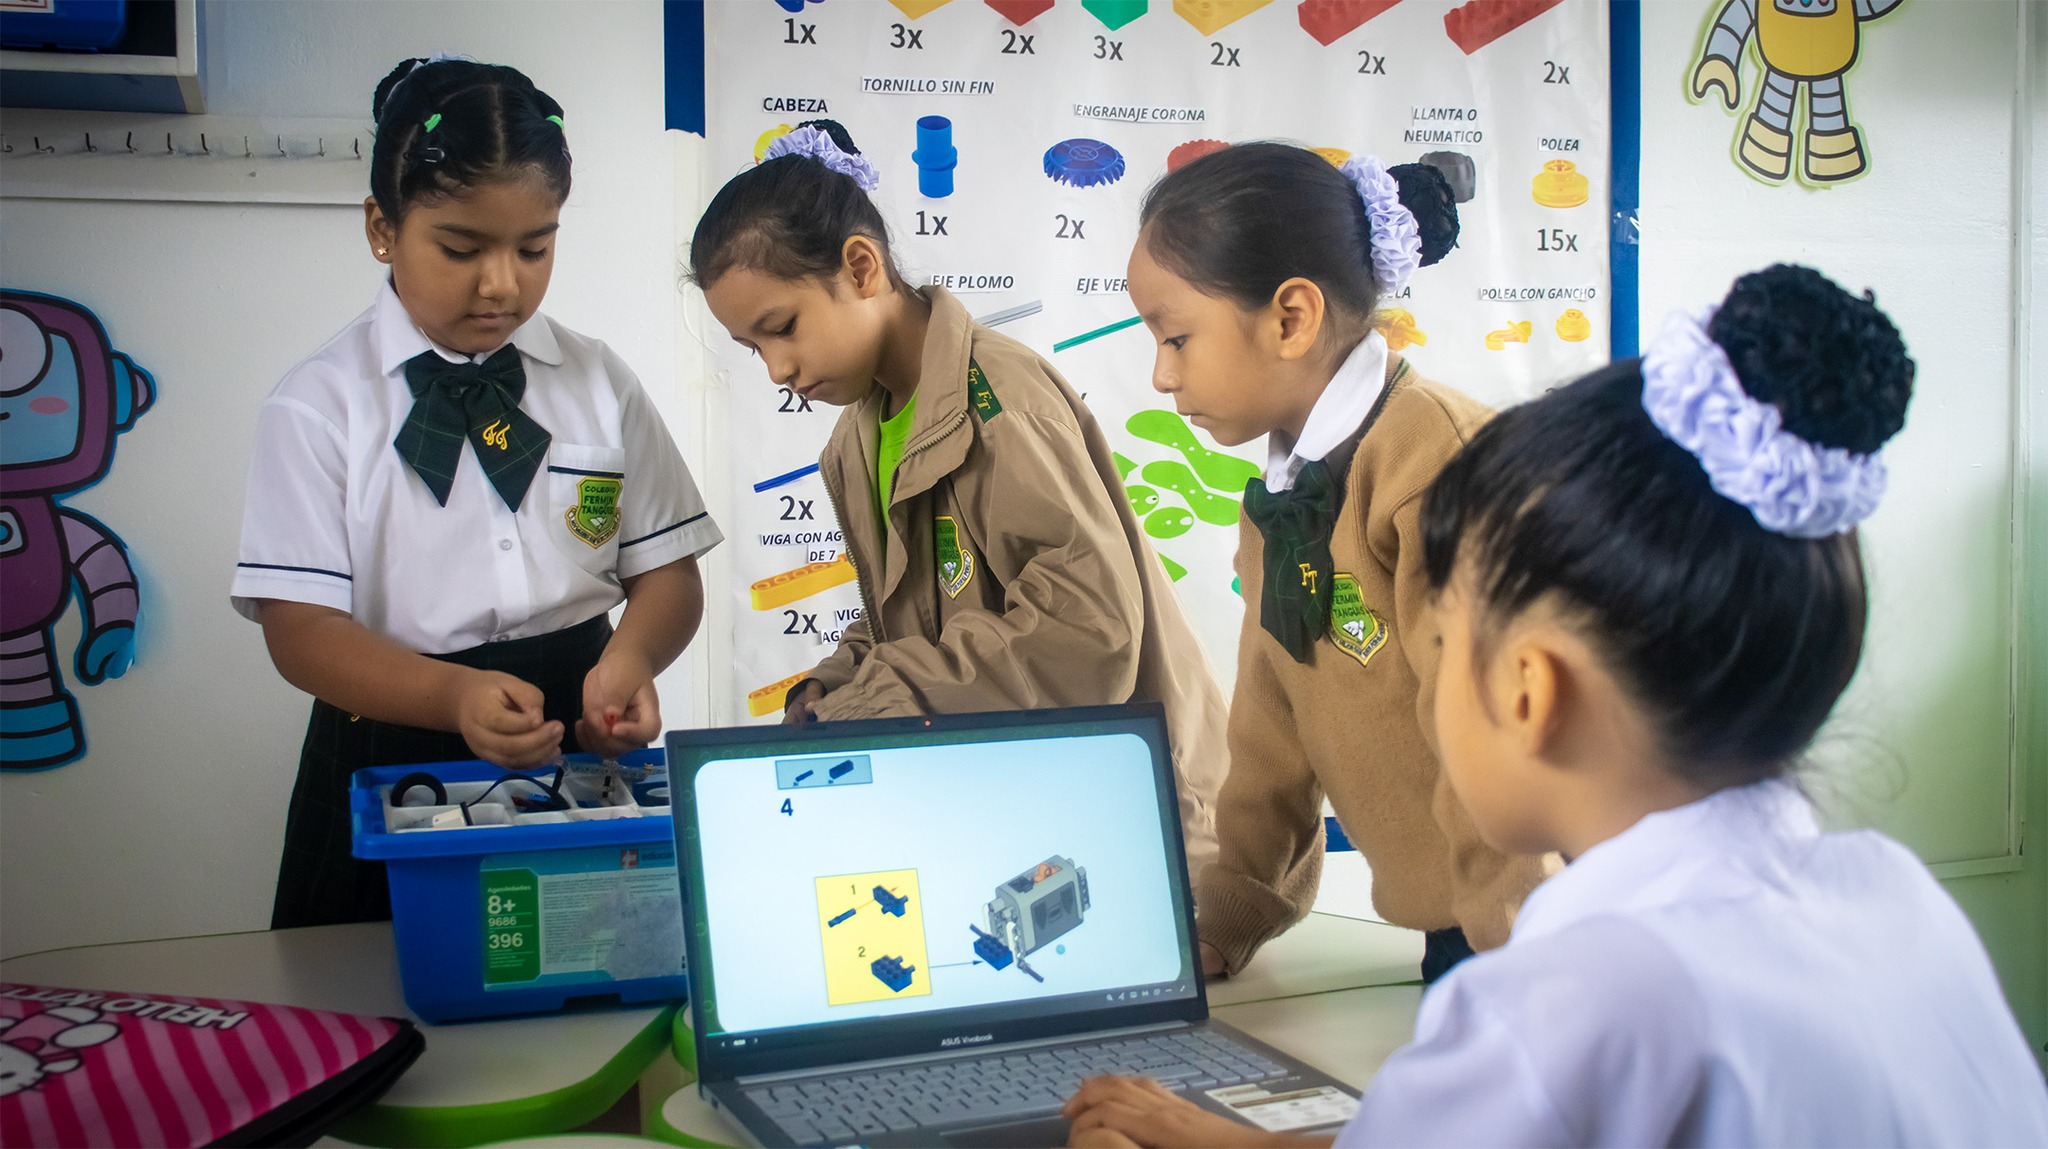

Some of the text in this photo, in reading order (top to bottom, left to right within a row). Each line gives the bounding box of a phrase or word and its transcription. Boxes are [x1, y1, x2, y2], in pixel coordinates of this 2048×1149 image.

[783, 18, 817, 45] 1x
[890, 23, 923, 50] 3x
[1001, 29, 1035, 55] 2x
[1094, 35, 1124, 61] 3x
[1210, 42, 1241, 67] 2x
[1357, 50, 1386, 75] 2x
[1543, 60, 1570, 85] 2x
[863, 78, 995, 94] TORNILLO SIN FIN
[763, 97, 828, 113] CABEZA
[1075, 104, 1206, 121] ENGRANAJE CORONA
[1413, 108, 1478, 121] LLANTA O
[1404, 130, 1483, 143] NEUMATICO
[1541, 138, 1579, 151] POLEA
[915, 210, 948, 236] 1x
[1055, 214, 1085, 239] 2x
[1537, 229, 1578, 252] 15x
[958, 275, 1014, 289] PLOMO
[1077, 278, 1100, 294] EJE
[1482, 288, 1596, 300] POLEA CON GANCHO
[778, 387, 814, 413] 2x
[780, 495, 815, 521] 2x
[762, 534, 791, 545] VIGA
[795, 532, 822, 544] CON
[810, 550, 836, 562] DE 7
[783, 609, 819, 635] 2x
[781, 798, 794, 817] 4
[850, 884, 856, 896] 1
[487, 894, 517, 915] 8+
[488, 916, 517, 928] 9686
[488, 932, 523, 949] 396
[857, 945, 867, 958] 2
[100, 998, 249, 1030] HELLO
[941, 1036, 961, 1047] ASUS
